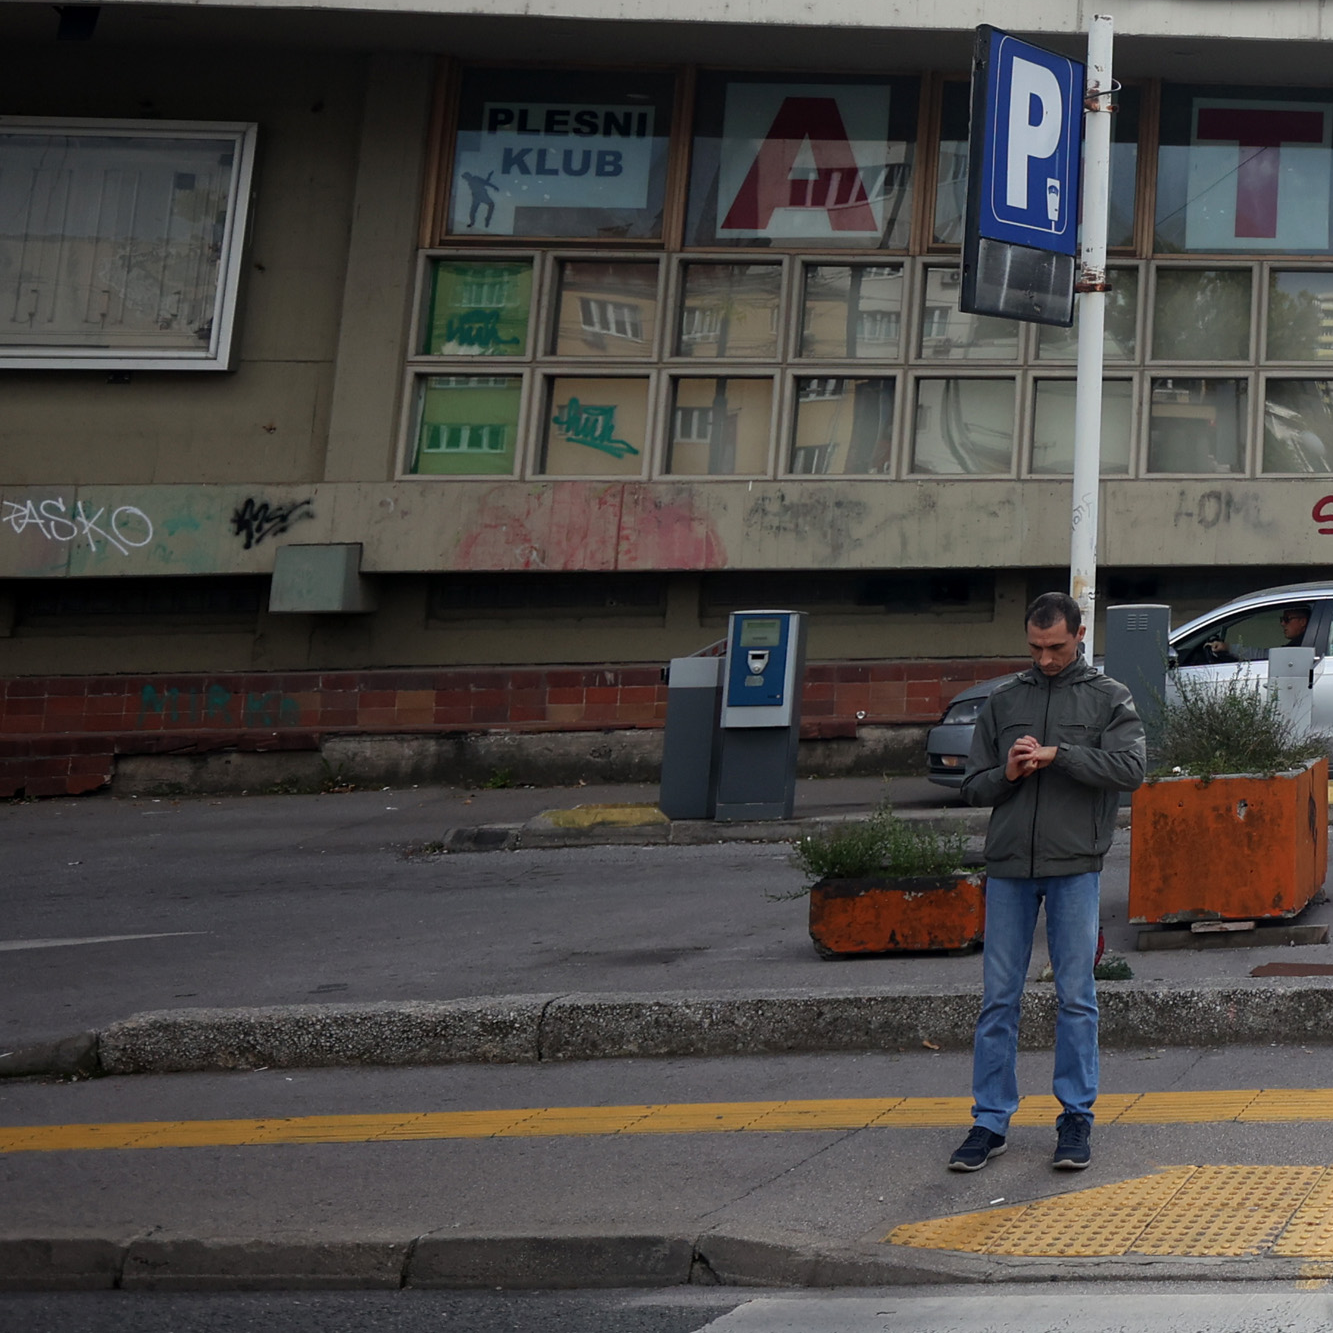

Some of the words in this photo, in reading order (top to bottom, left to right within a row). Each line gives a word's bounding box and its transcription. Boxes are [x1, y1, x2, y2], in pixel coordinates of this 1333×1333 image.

[486, 107, 648, 140] PLESNI
[1006, 56, 1063, 210] P
[501, 149, 625, 178] KLUB
